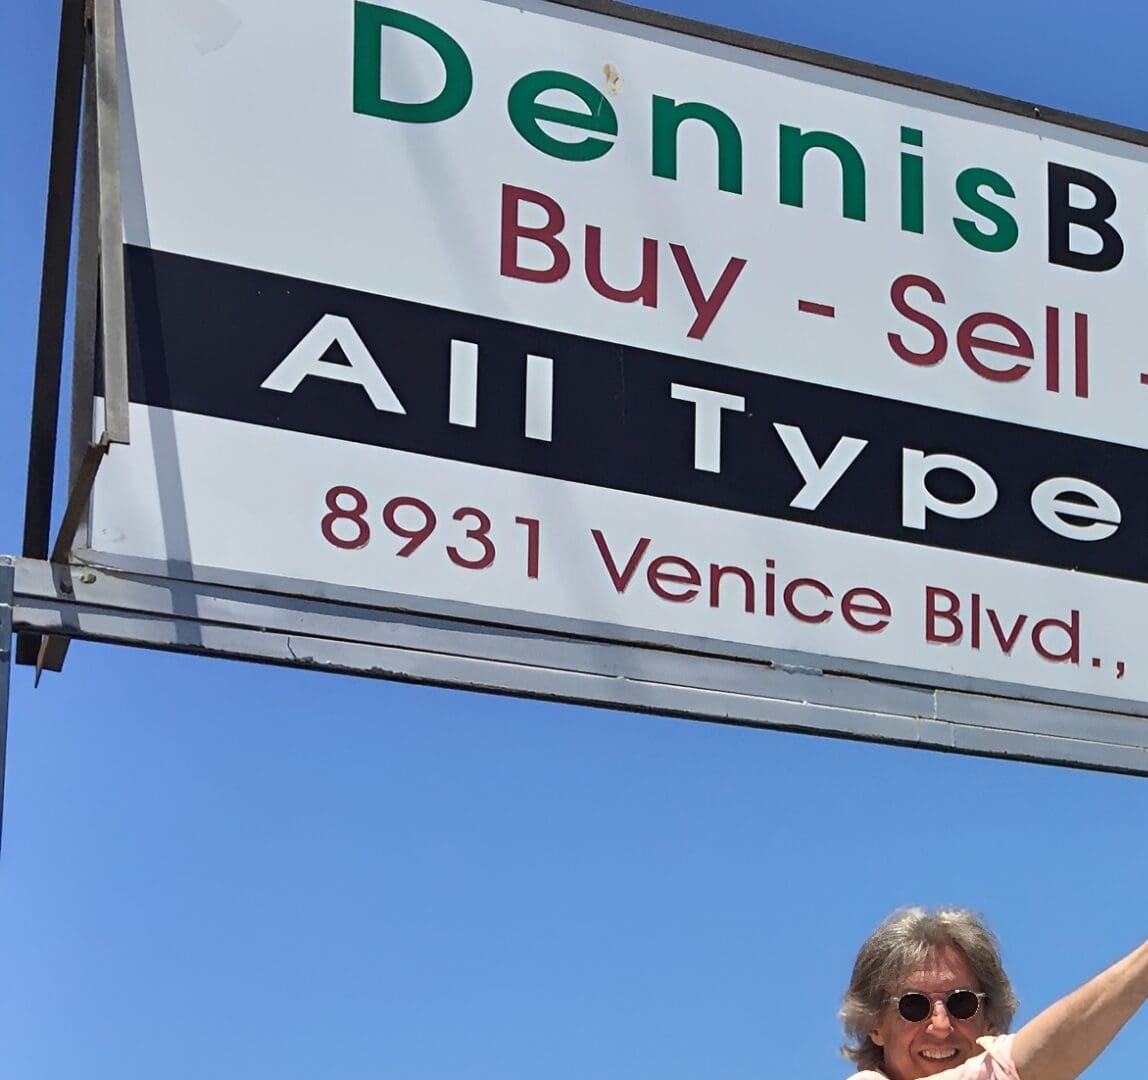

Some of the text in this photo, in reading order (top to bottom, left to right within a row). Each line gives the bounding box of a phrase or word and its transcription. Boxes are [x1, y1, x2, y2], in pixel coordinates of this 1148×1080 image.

[260, 313, 554, 442] All
[500, 183, 748, 341] Buy
[798, 298, 836, 318] -
[887, 273, 1089, 399] Sell
[320, 485, 541, 579] 8931
[591, 528, 893, 634] Venice
[925, 585, 1126, 680] Blvd.,
